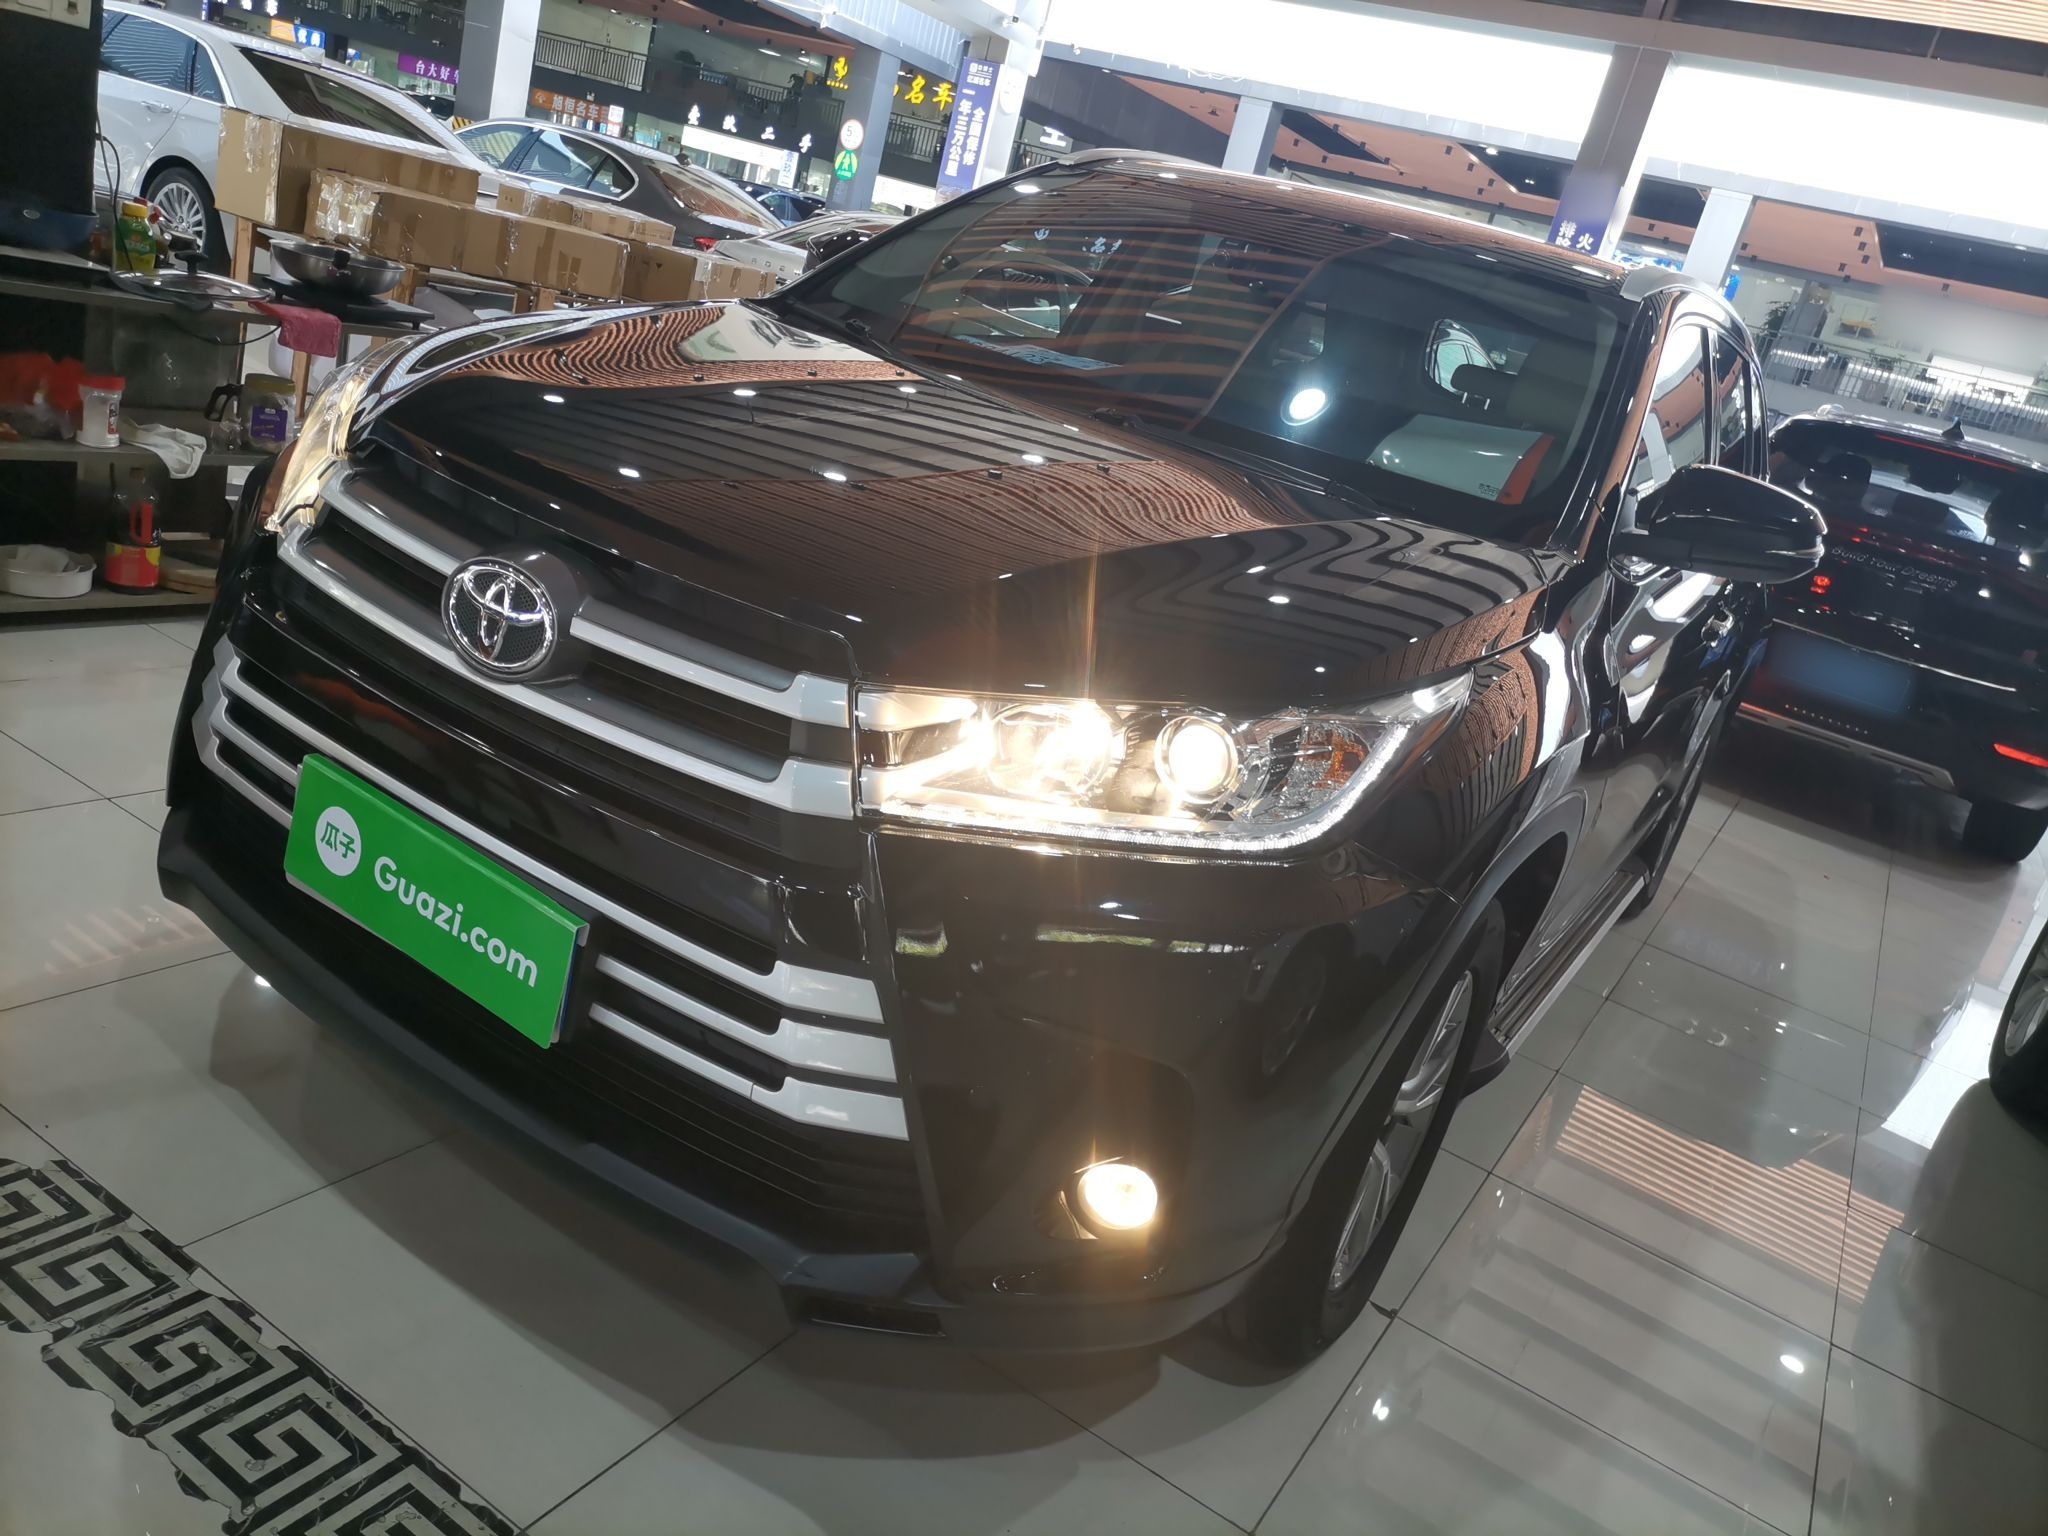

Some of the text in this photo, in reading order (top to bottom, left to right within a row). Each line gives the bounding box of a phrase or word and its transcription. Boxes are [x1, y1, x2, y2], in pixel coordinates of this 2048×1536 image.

[893, 74, 955, 112] 名车
[320, 821, 356, 859] 瓜子
[374, 855, 539, 988] Guazi.com
